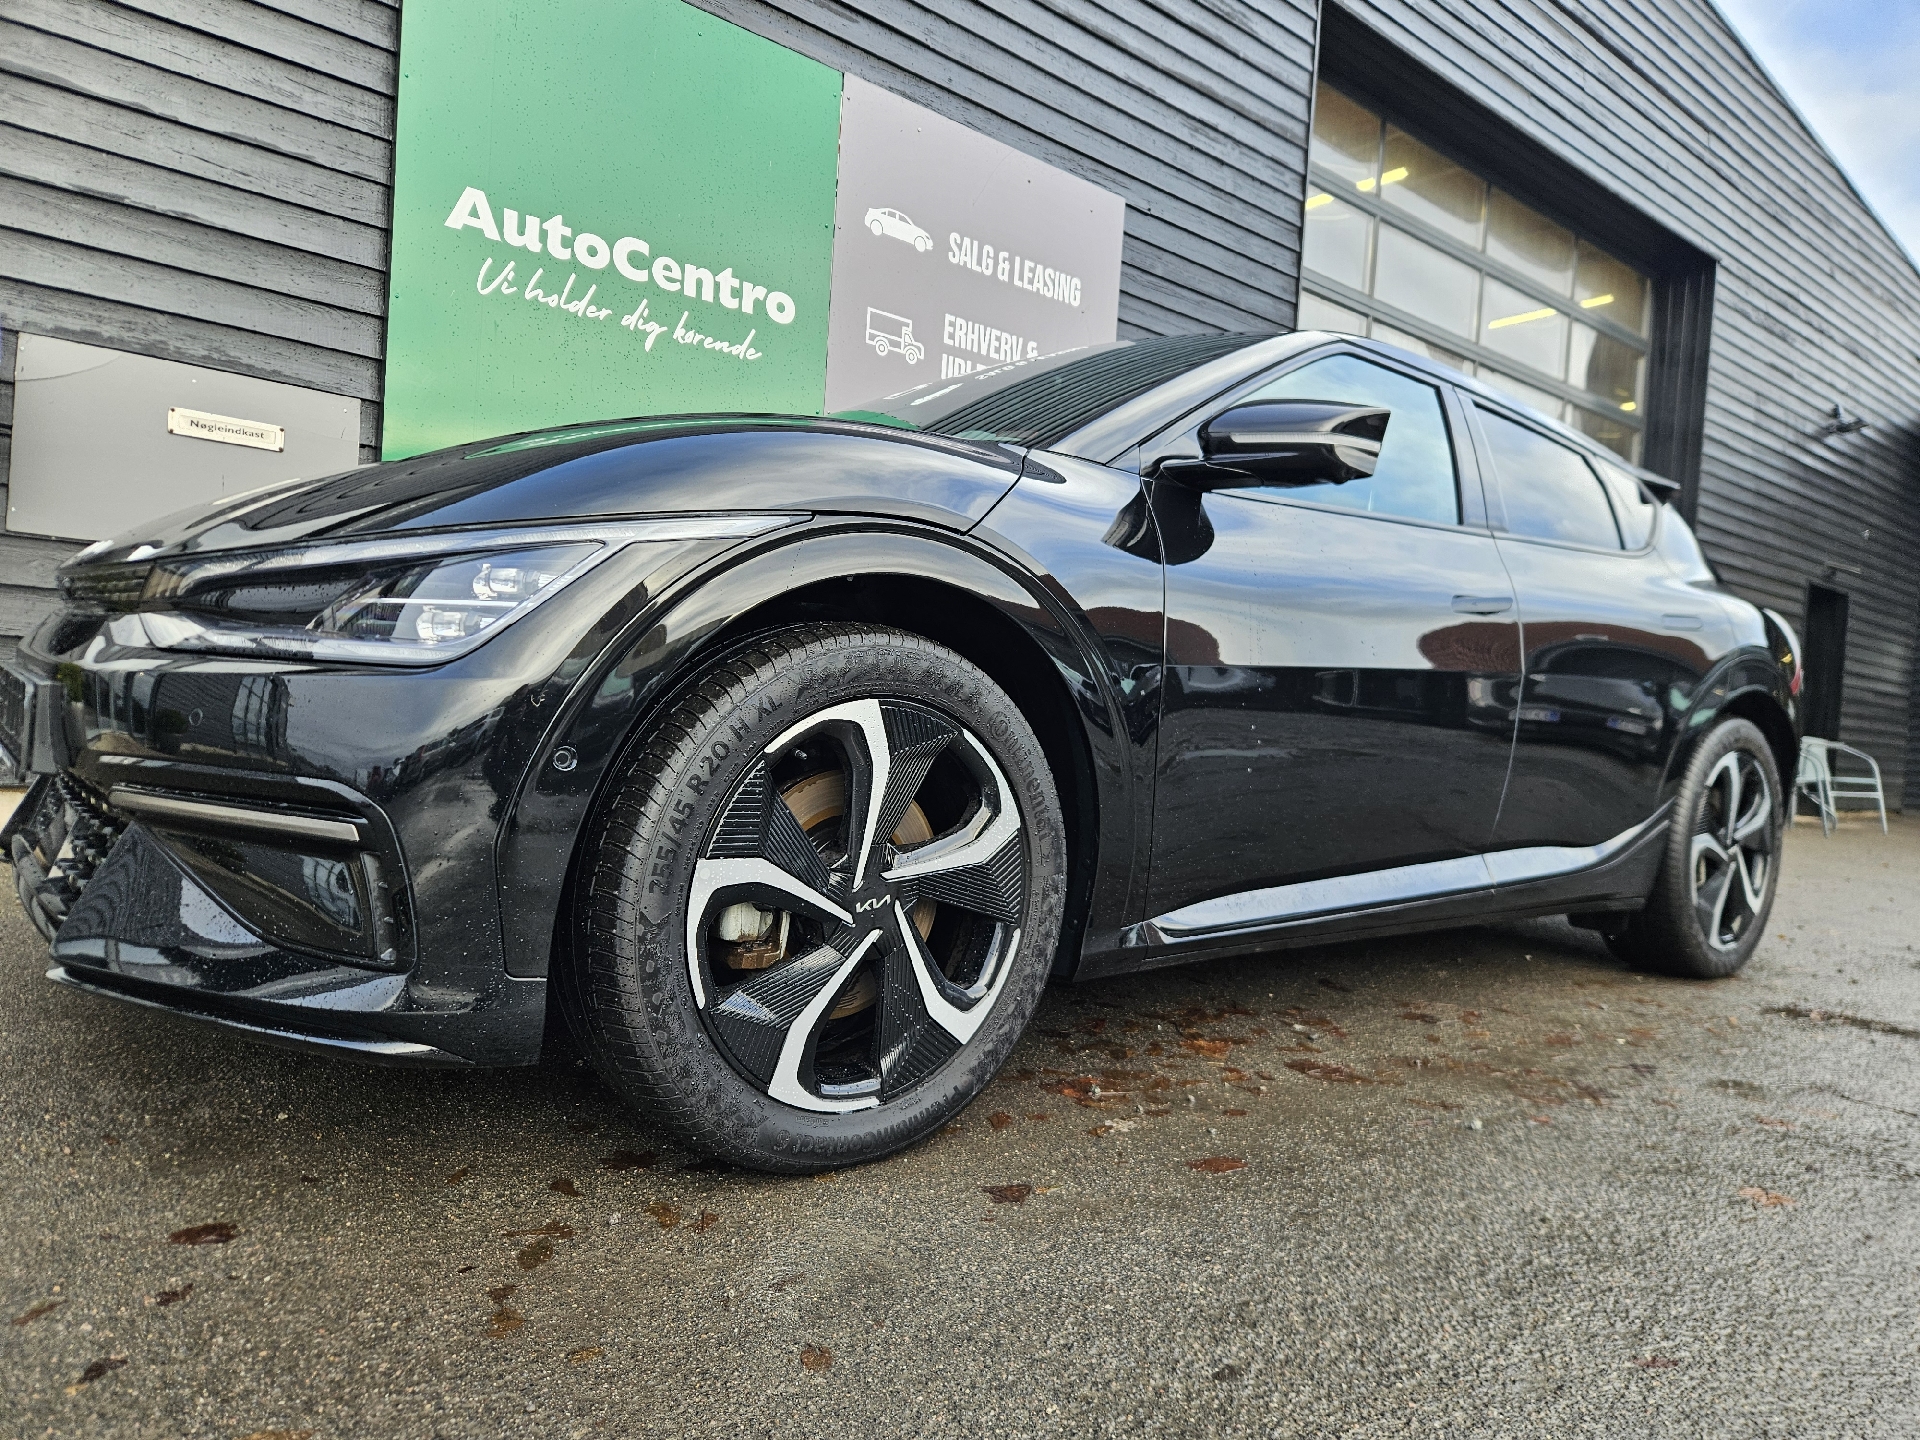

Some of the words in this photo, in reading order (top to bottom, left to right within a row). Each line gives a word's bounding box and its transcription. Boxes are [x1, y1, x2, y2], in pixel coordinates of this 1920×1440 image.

[444, 186, 796, 324] AutoCentro
[948, 232, 994, 276] SALG
[997, 251, 1010, 282] &
[1013, 256, 1082, 307] LEASING
[476, 257, 518, 296] Vi
[524, 268, 612, 321] holder
[620, 299, 668, 352] dig
[943, 313, 1024, 362] ERHVERV
[189, 419, 265, 439] Nøgleindkast
[649, 798, 694, 896] 255/45
